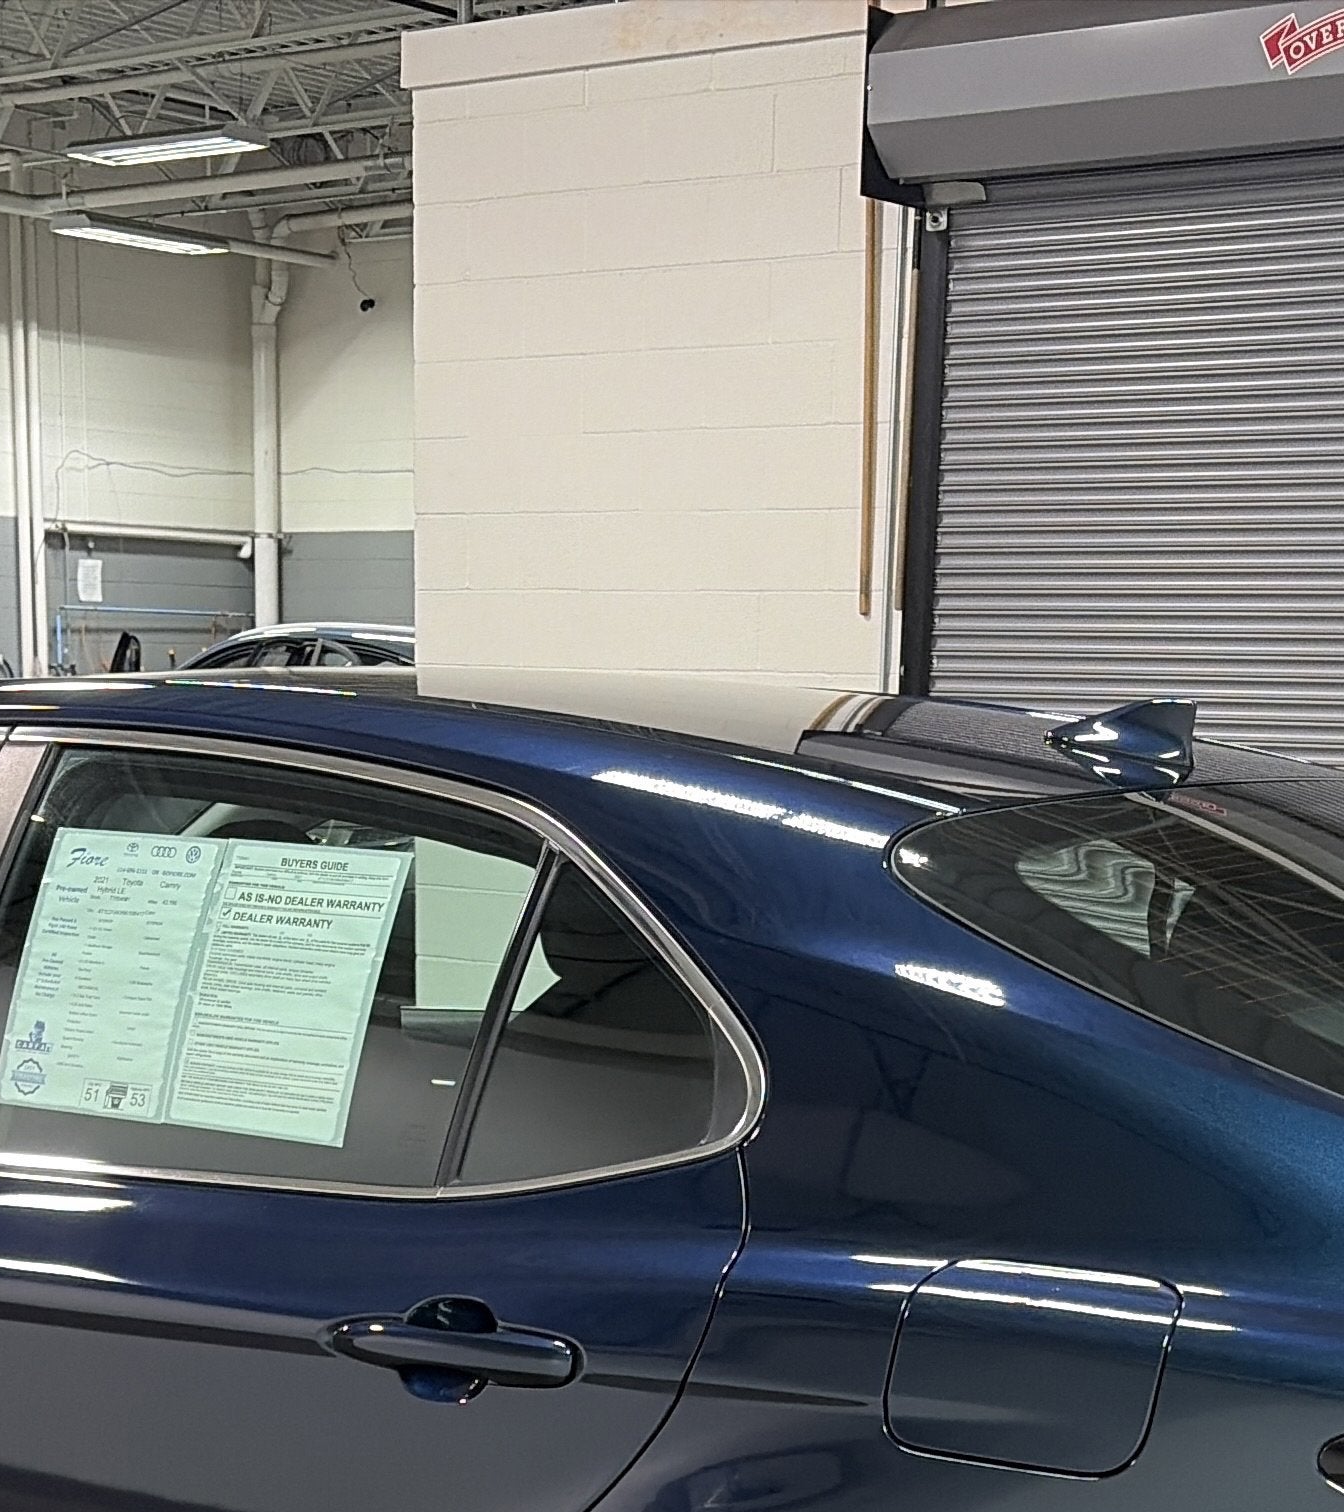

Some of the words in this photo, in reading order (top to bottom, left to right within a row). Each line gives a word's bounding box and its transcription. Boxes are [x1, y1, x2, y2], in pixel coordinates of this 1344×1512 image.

[66, 847, 110, 868] Fiore
[280, 857, 318, 870] BUYERS
[320, 860, 349, 872] GUIDE
[55, 884, 89, 894] Pre-owned
[97, 886, 116, 896] Hybrid
[122, 877, 144, 887] Toyota
[159, 881, 181, 890] Camry
[238, 892, 253, 902] AS
[284, 896, 324, 908] DEALER
[326, 899, 385, 912] WARRANTY
[232, 911, 273, 924] DEALER
[275, 915, 333, 930] WARRANTY
[84, 1087, 99, 1102] 51
[129, 1092, 146, 1107] 53
